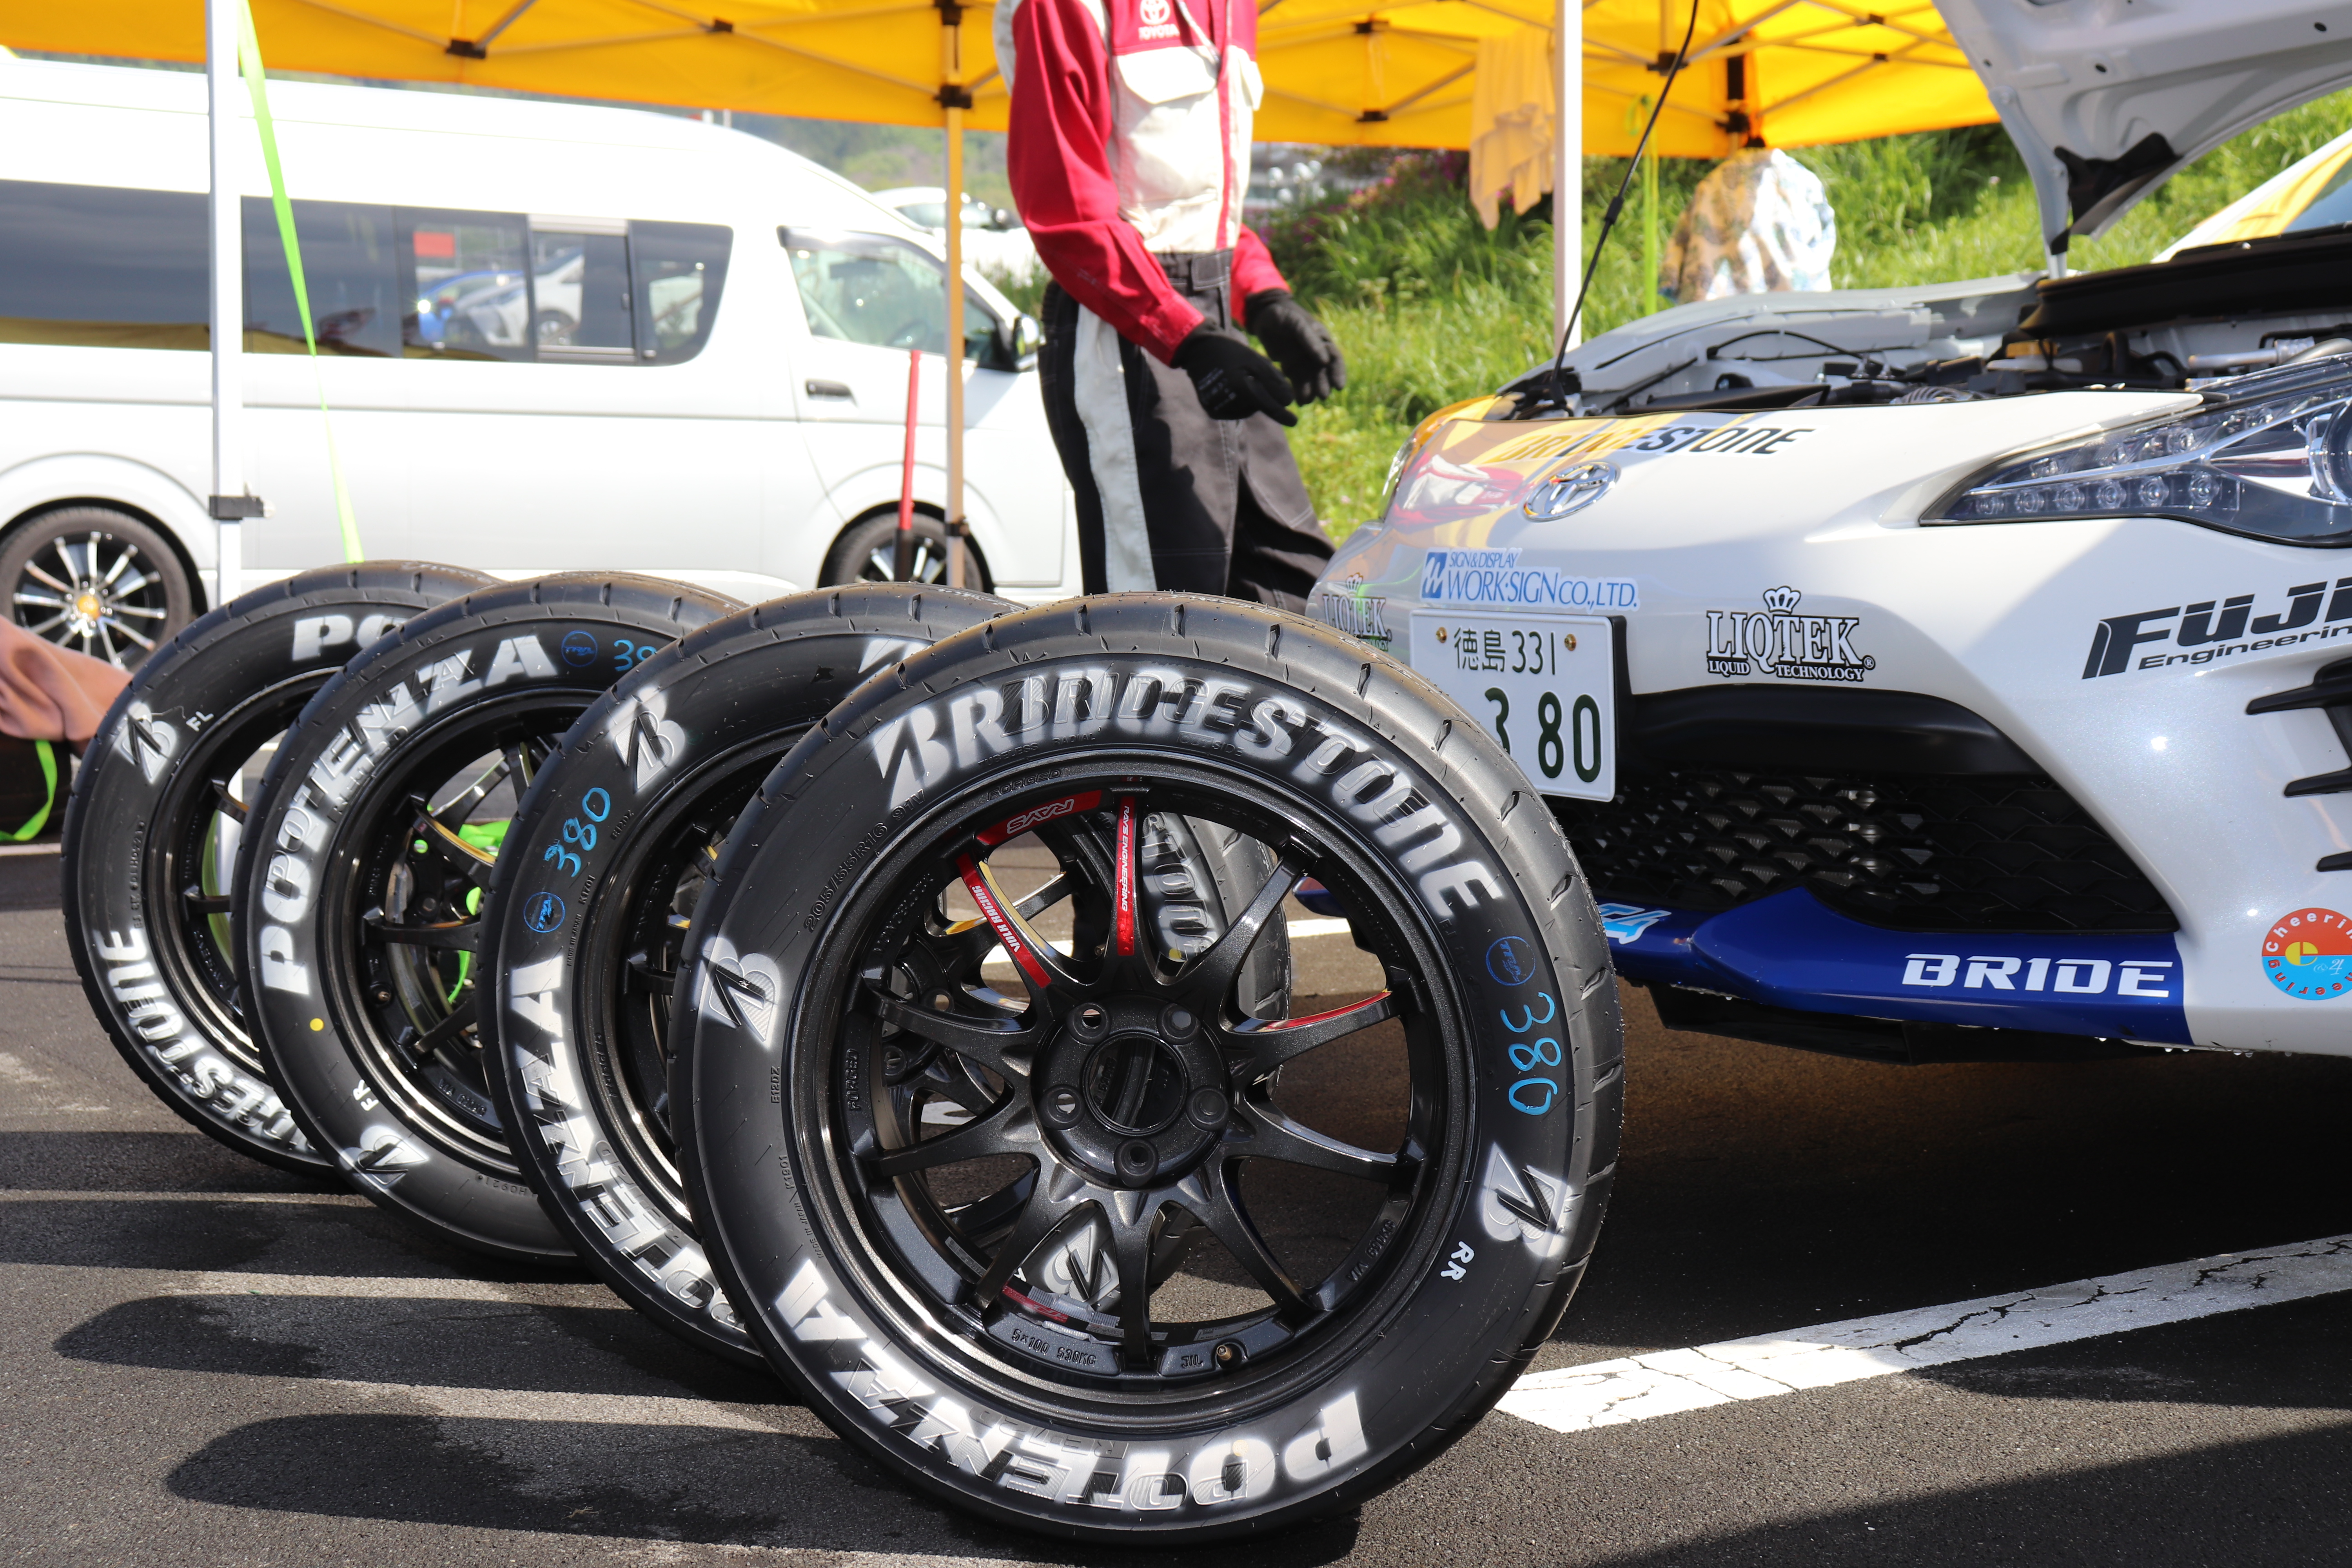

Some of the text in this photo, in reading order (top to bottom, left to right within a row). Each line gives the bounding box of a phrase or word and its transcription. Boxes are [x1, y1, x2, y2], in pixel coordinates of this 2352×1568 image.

[1138, 24, 1180, 40] TOYOTA
[1497, 426, 1814, 462] BRIDGESTONE
[1454, 628, 1555, 675] 徳島 331
[1707, 610, 1863, 673] LIQTEK
[2138, 625, 2352, 670] Engineerin
[1708, 660, 1864, 681] LIQUID TECHNOLOGY
[186, 710, 215, 733] FL
[1538, 691, 1601, 783] 80
[870, 665, 1502, 919] BRIDGESTONE
[986, 769, 1062, 800] FORGED
[261, 635, 559, 996] POTENZA
[543, 786, 612, 878] 380
[1007, 799, 1074, 835] RAYS
[802, 822, 889, 933] 205/55R16
[971, 885, 1021, 953] VOLK RACING
[1902, 953, 2174, 998] BRIDE
[1499, 991, 1563, 1116] 380
[351, 1078, 372, 1112] FR
[778, 1154, 795, 1189] K1901
[1440, 1239, 1476, 1283] RR
[775, 1258, 1368, 1510] POTENZA
